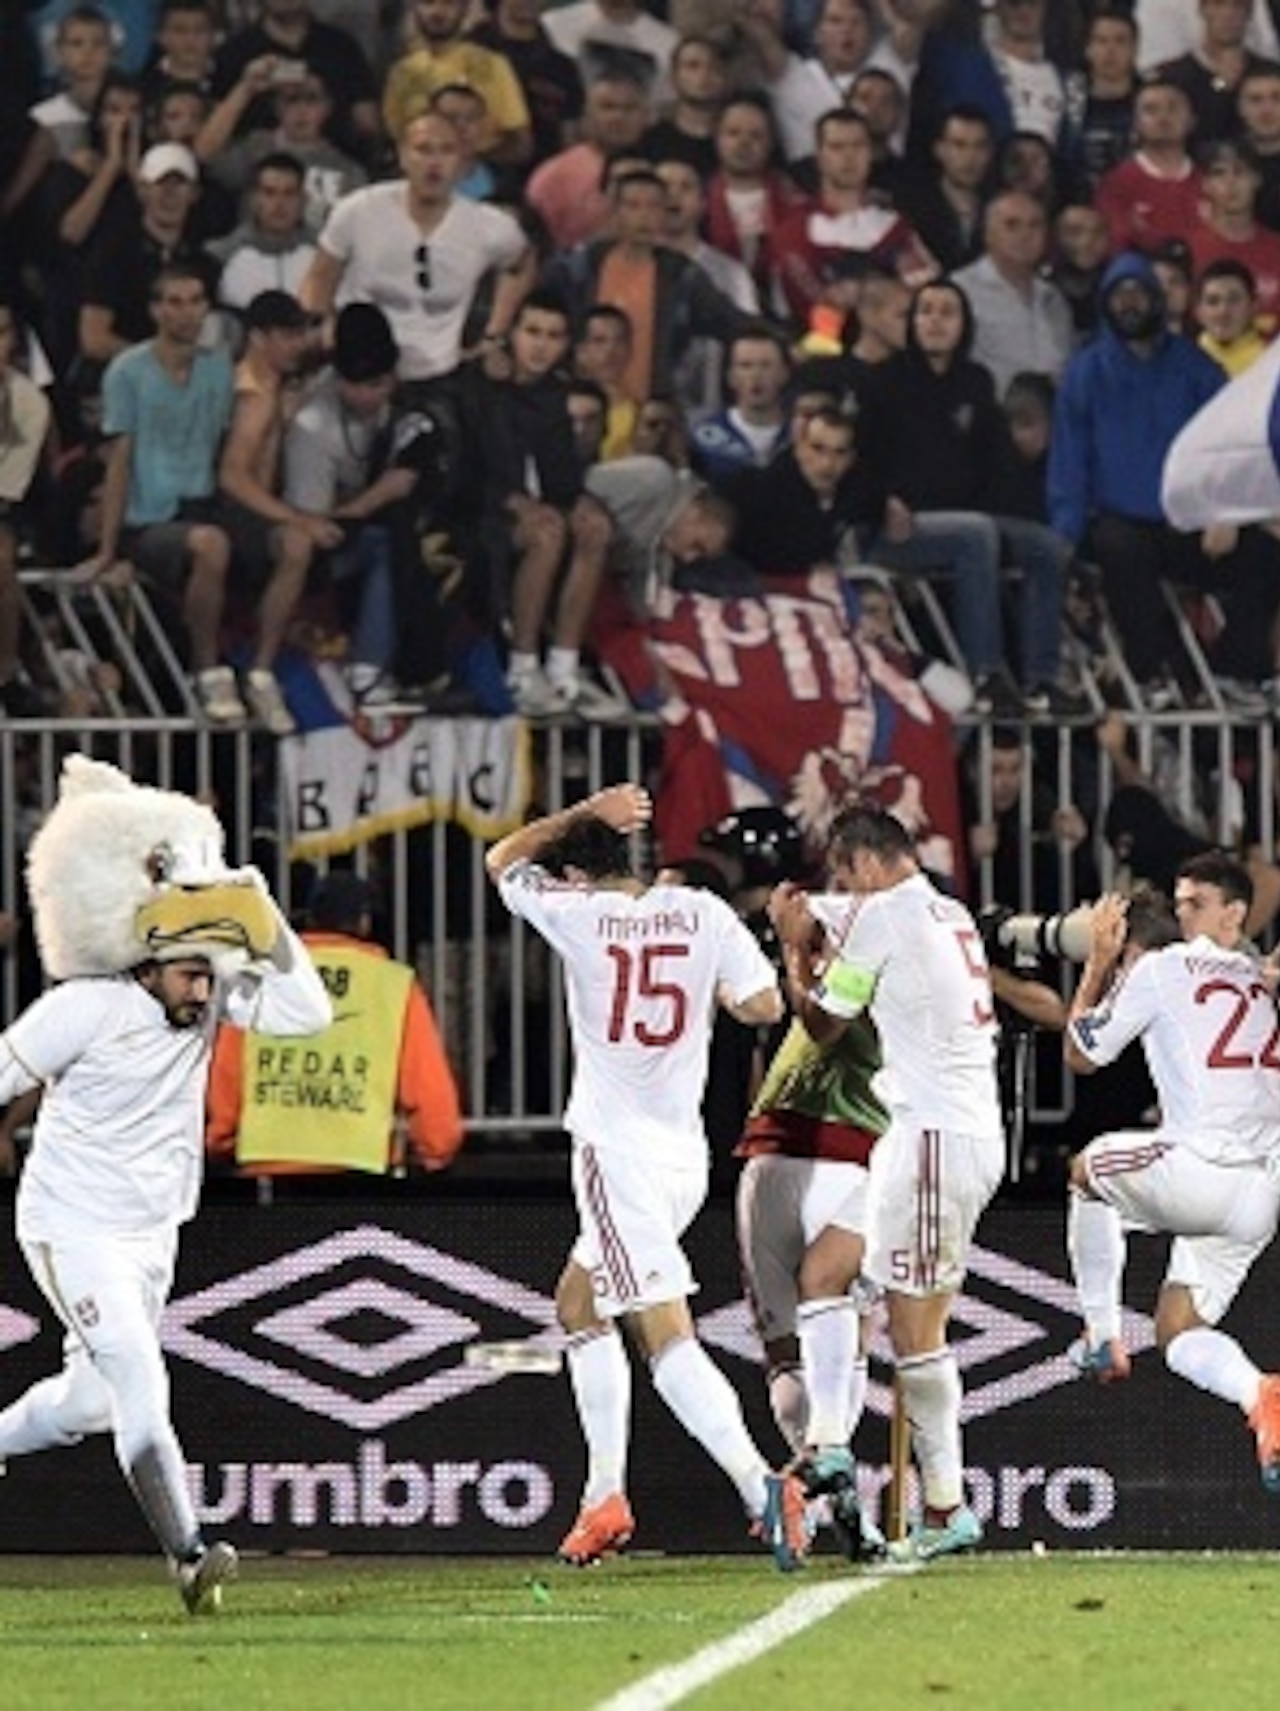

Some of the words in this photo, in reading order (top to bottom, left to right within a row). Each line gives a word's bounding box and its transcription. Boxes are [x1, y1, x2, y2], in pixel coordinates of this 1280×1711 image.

[607, 943, 690, 1047] 15
[257, 1046, 370, 1084] REDAR
[890, 1249, 910, 1281] 5
[183, 1437, 555, 1528] umbro
